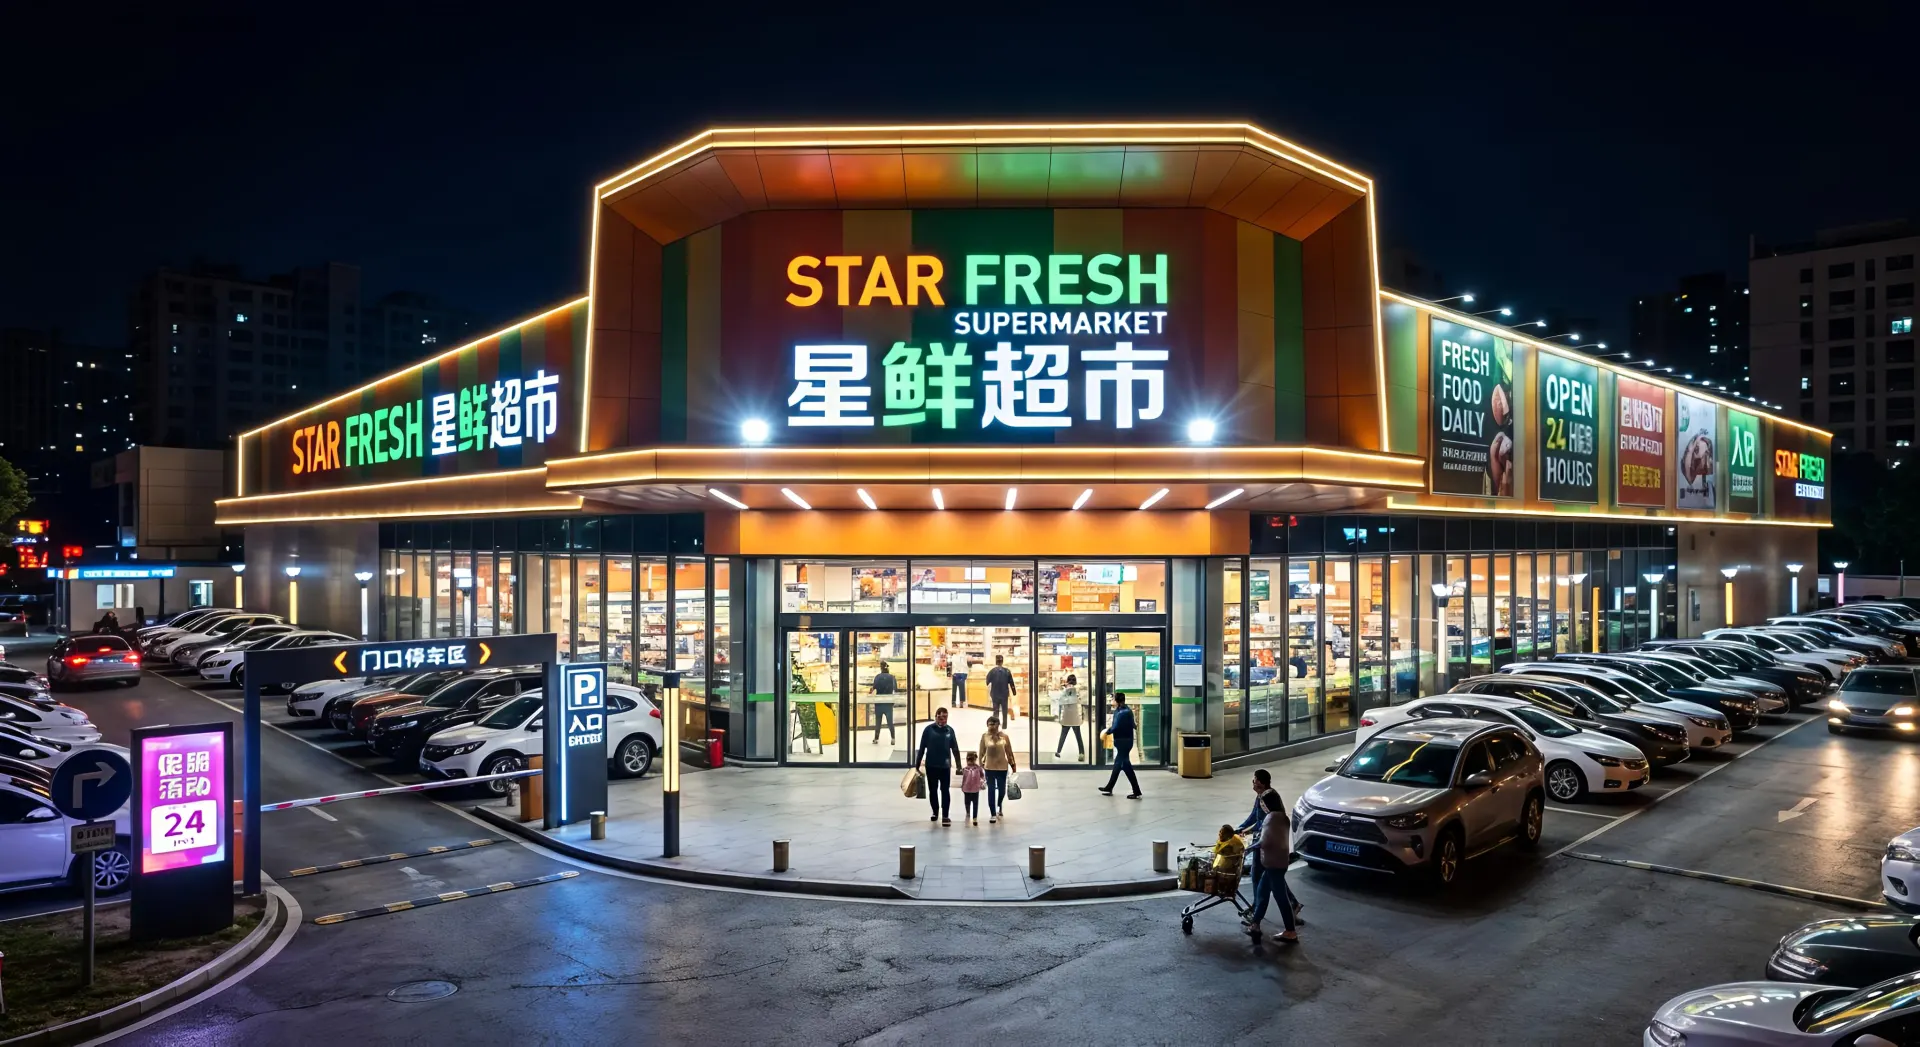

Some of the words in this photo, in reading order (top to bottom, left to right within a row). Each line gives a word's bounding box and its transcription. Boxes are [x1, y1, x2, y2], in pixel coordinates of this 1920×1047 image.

[785, 255, 945, 307] STAR
[965, 253, 1168, 305] FRESH
[953, 311, 1168, 335] SUPERMARKET
[1441, 339, 1490, 376] FRESH
[787, 341, 1169, 429] 星鲜超市
[1442, 372, 1482, 405] FOOD
[1546, 373, 1593, 419] OPEN
[292, 420, 341, 475] STAR
[345, 399, 423, 467] FRESH
[430, 369, 560, 456] 星鲜超市
[1441, 405, 1485, 438] DAILY
[1546, 456, 1593, 487] HOURS
[568, 713, 603, 734] 入口
[164, 809, 206, 838] 24
